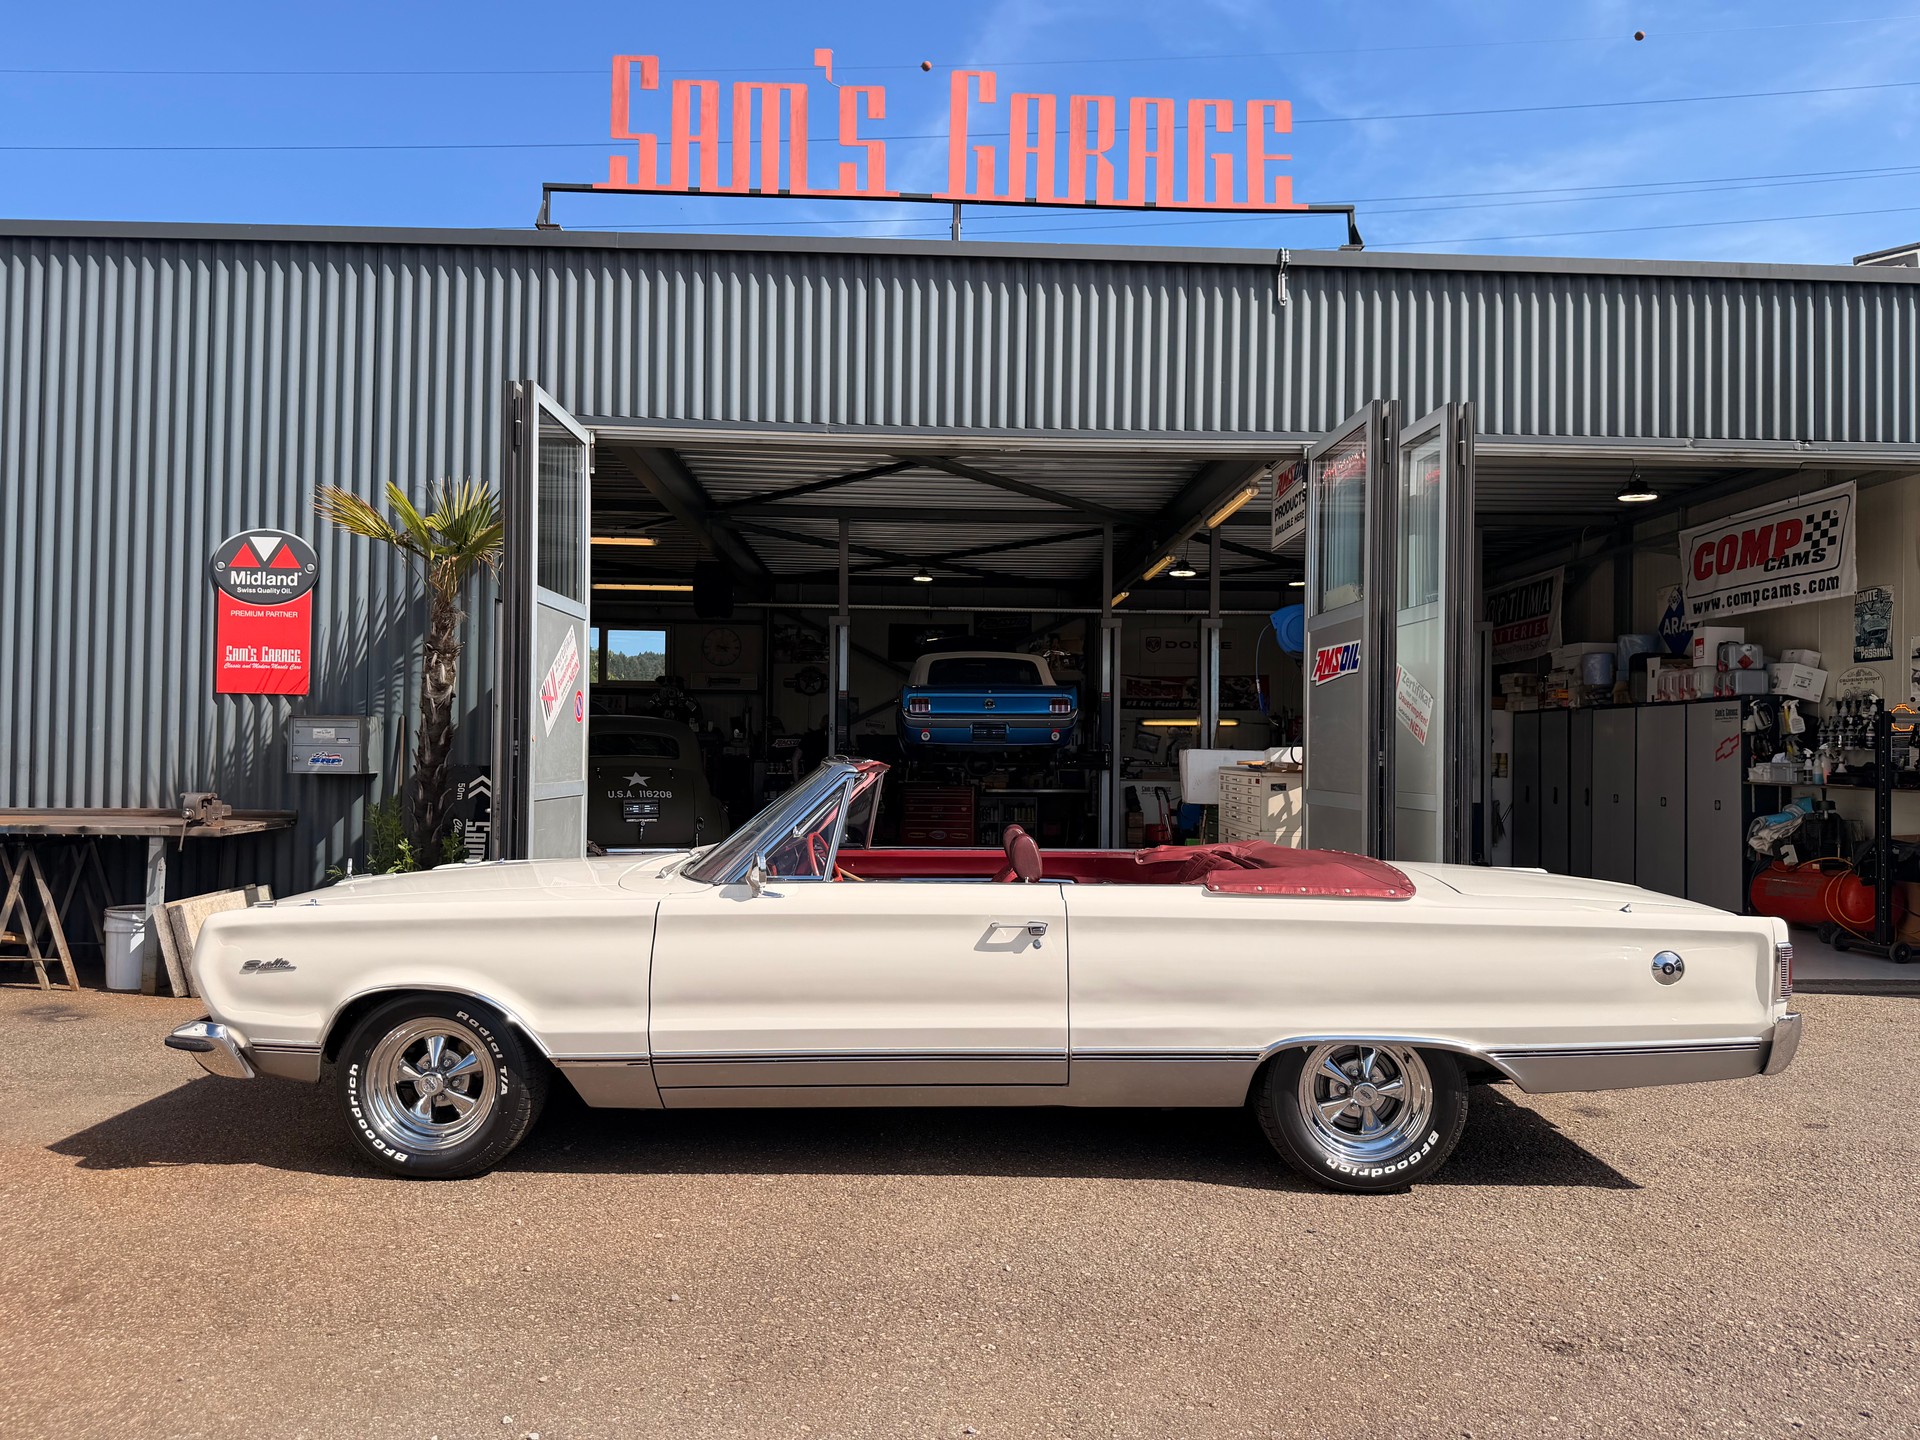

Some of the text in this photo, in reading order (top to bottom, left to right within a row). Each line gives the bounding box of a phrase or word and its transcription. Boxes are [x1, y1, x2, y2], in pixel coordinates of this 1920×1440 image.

[1276, 460, 1303, 498] AMSOI
[1275, 490, 1306, 522] PRODUCTS
[1275, 509, 1305, 536] AVAILABLE HERE
[1693, 518, 1804, 581] COMP
[1763, 547, 1827, 572] CAMS
[231, 570, 300, 586] Midland
[257, 587, 280, 595] Quality
[1486, 581, 1551, 624] OPTIMA
[1693, 576, 1840, 614] www.compcams.com
[230, 609, 299, 618] PREMIUM PARTNER
[1493, 620, 1547, 644] ATTERIES
[1312, 642, 1360, 683] AMSOIL
[1402, 671, 1432, 709] Zertifikat
[1409, 718, 1426, 744] NEIN
[456, 782, 466, 801] 50m
[607, 790, 673, 798] U.S.A. 116208
[456, 1010, 508, 1096] Radial T/A
[347, 1063, 409, 1164] BFGoodrich
[1325, 1130, 1440, 1178] BFGoodrich
